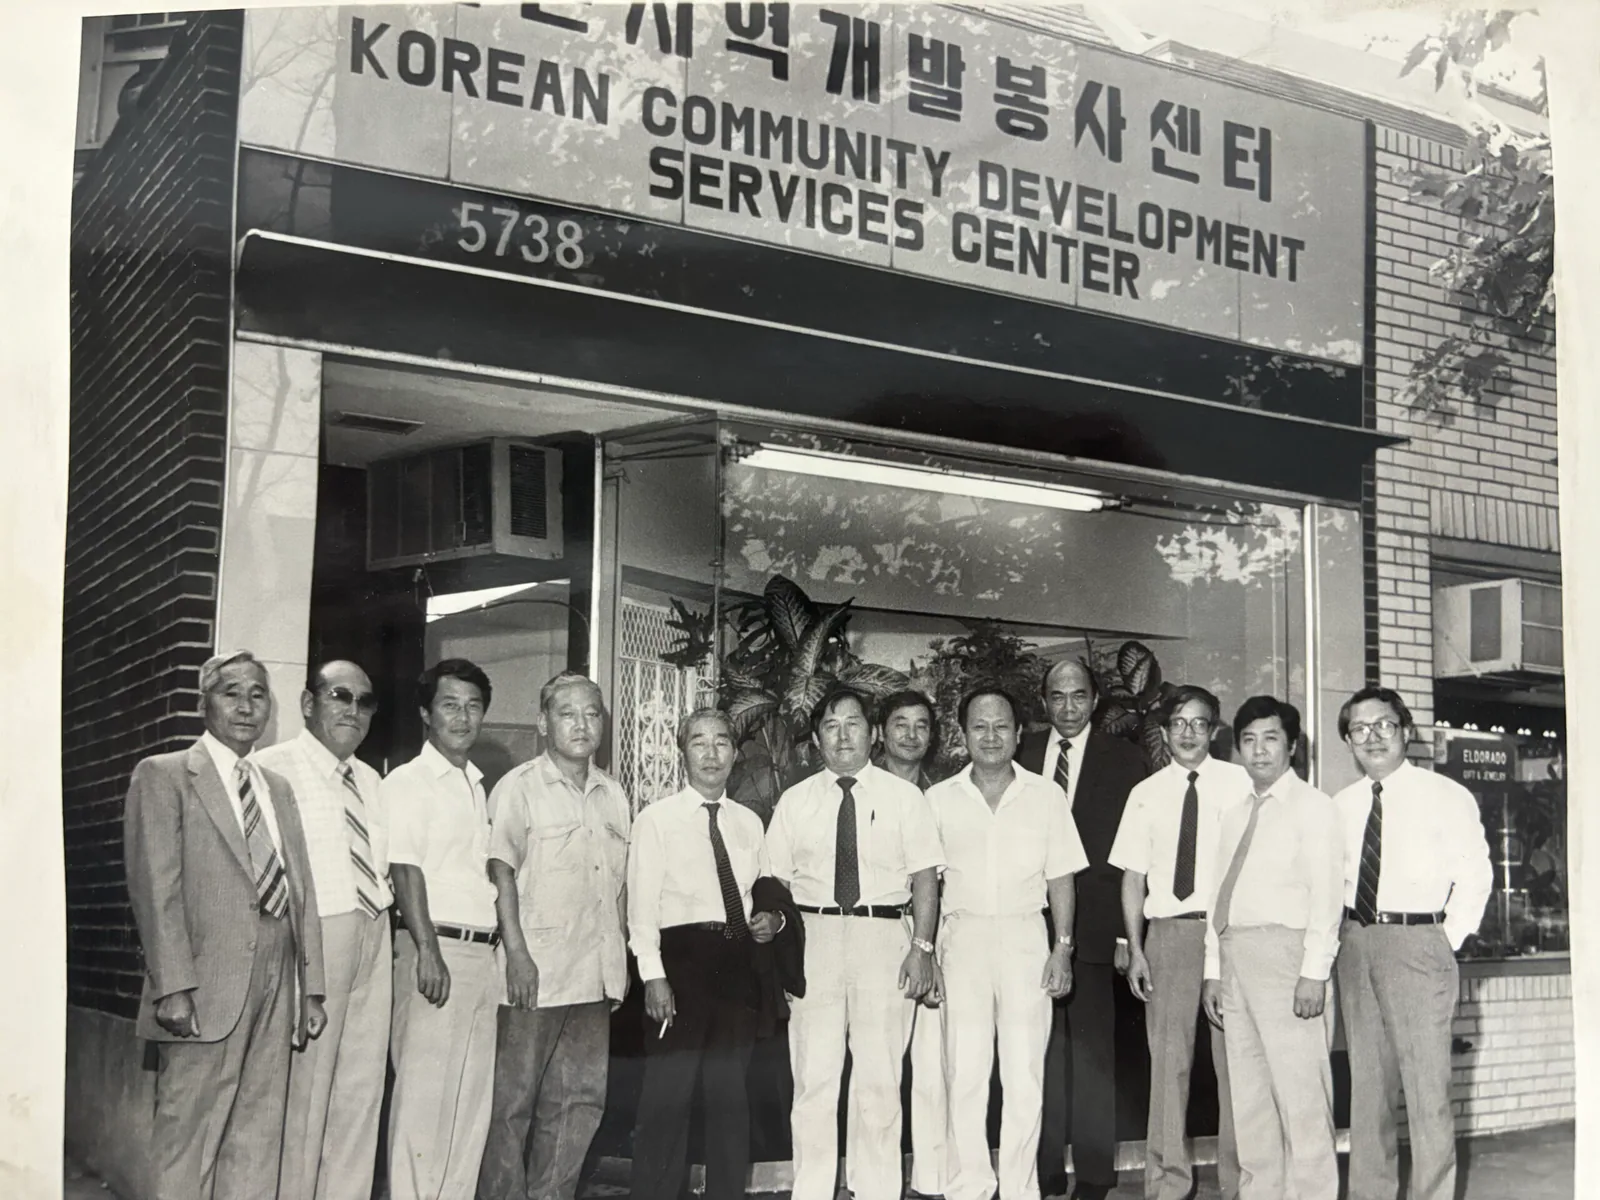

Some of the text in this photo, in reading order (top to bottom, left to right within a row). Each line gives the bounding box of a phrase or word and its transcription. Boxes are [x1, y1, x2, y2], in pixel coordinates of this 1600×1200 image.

[351, 17, 1305, 282] KOREAN COMMUNITY DEVELOPMENT
[452, 3, 1273, 203] 지역개발봉사센터
[456, 202, 584, 269] 5738
[649, 146, 1140, 299] SERVICES CENTER
[1463, 749, 1507, 765] ELDORADO
